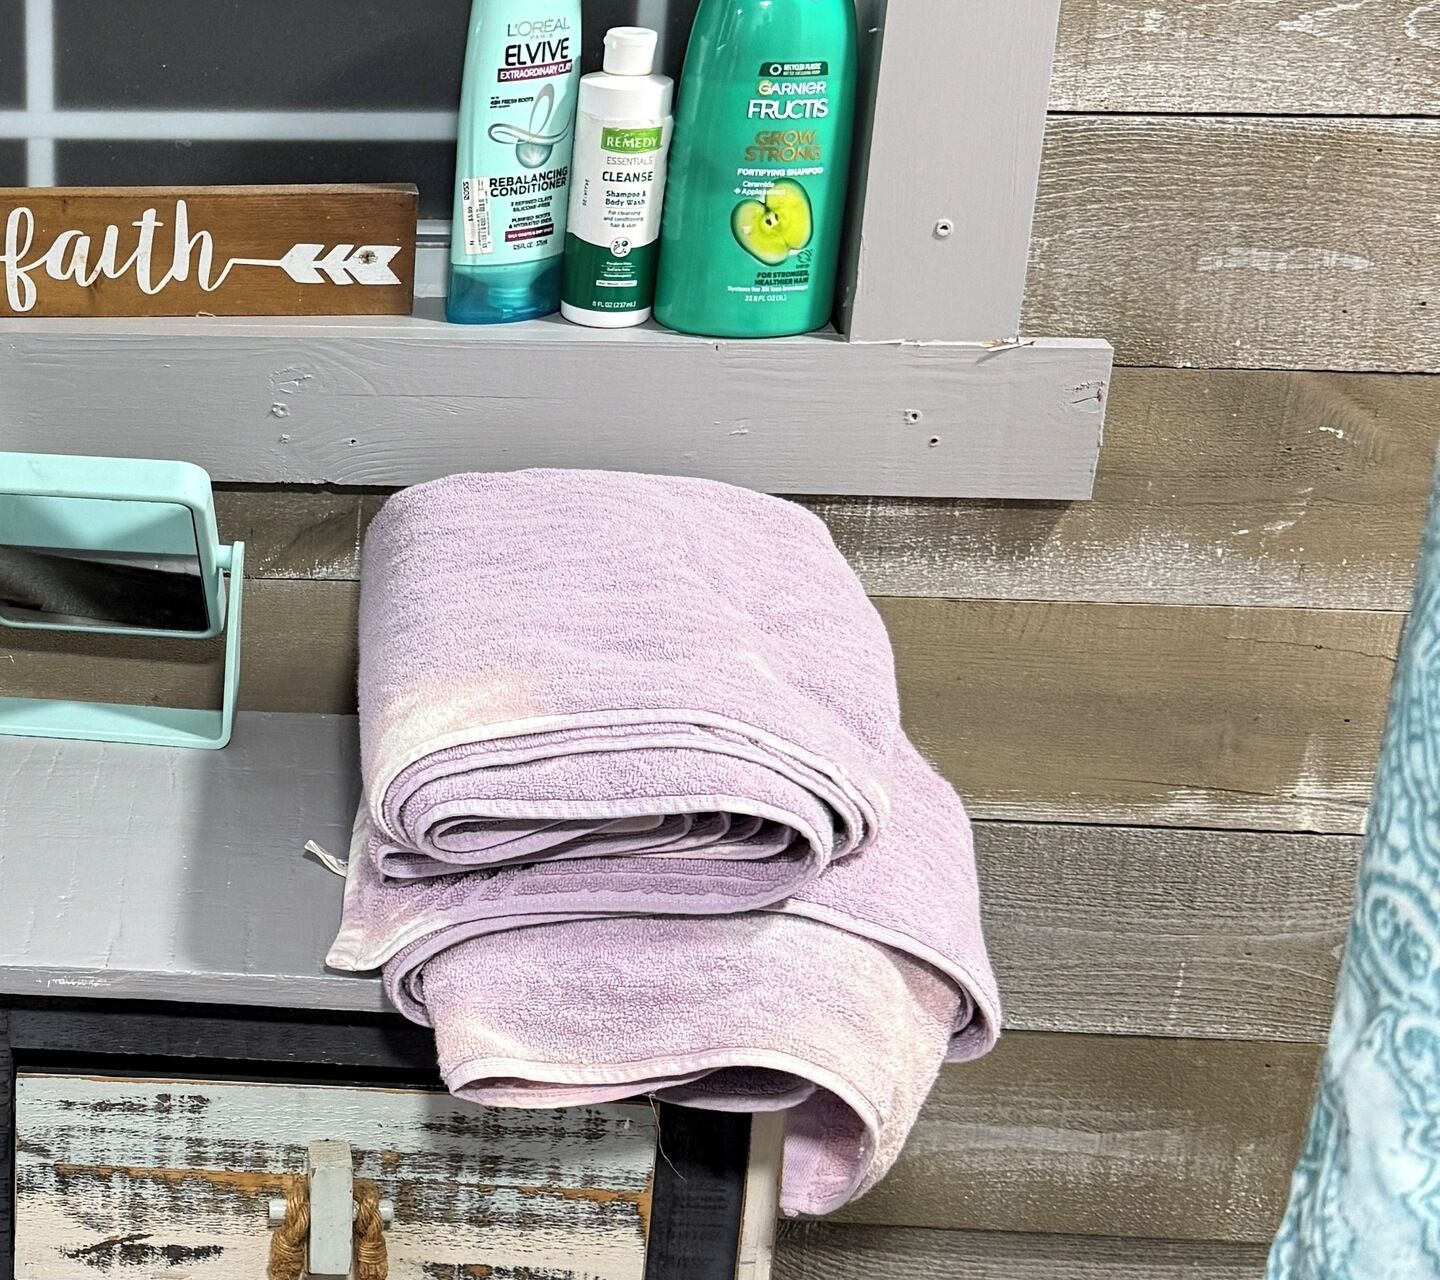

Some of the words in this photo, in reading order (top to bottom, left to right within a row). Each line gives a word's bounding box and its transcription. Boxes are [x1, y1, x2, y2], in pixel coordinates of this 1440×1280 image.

[507, 17, 570, 37] L'ORÉAL
[505, 37, 569, 66] ELVIVE
[500, 64, 558, 80] EXTRAORDINARY
[759, 80, 827, 95] GARNIER
[747, 98, 829, 119] FRUCTIS
[606, 136, 658, 148] REMEDY
[755, 130, 815, 145] GROW
[607, 156, 653, 165] ESSENTIALS
[744, 145, 821, 161] STRONG
[489, 166, 568, 187] REBALANCING
[602, 171, 653, 182] CLEANSE
[737, 168, 785, 176] FORTIFYING
[786, 167, 823, 176] SHAMPOO
[490, 177, 567, 197] CONDITIONER
[606, 190, 640, 198] Shampoo
[605, 198, 624, 206] Body
[5, 200, 232, 312] faith
